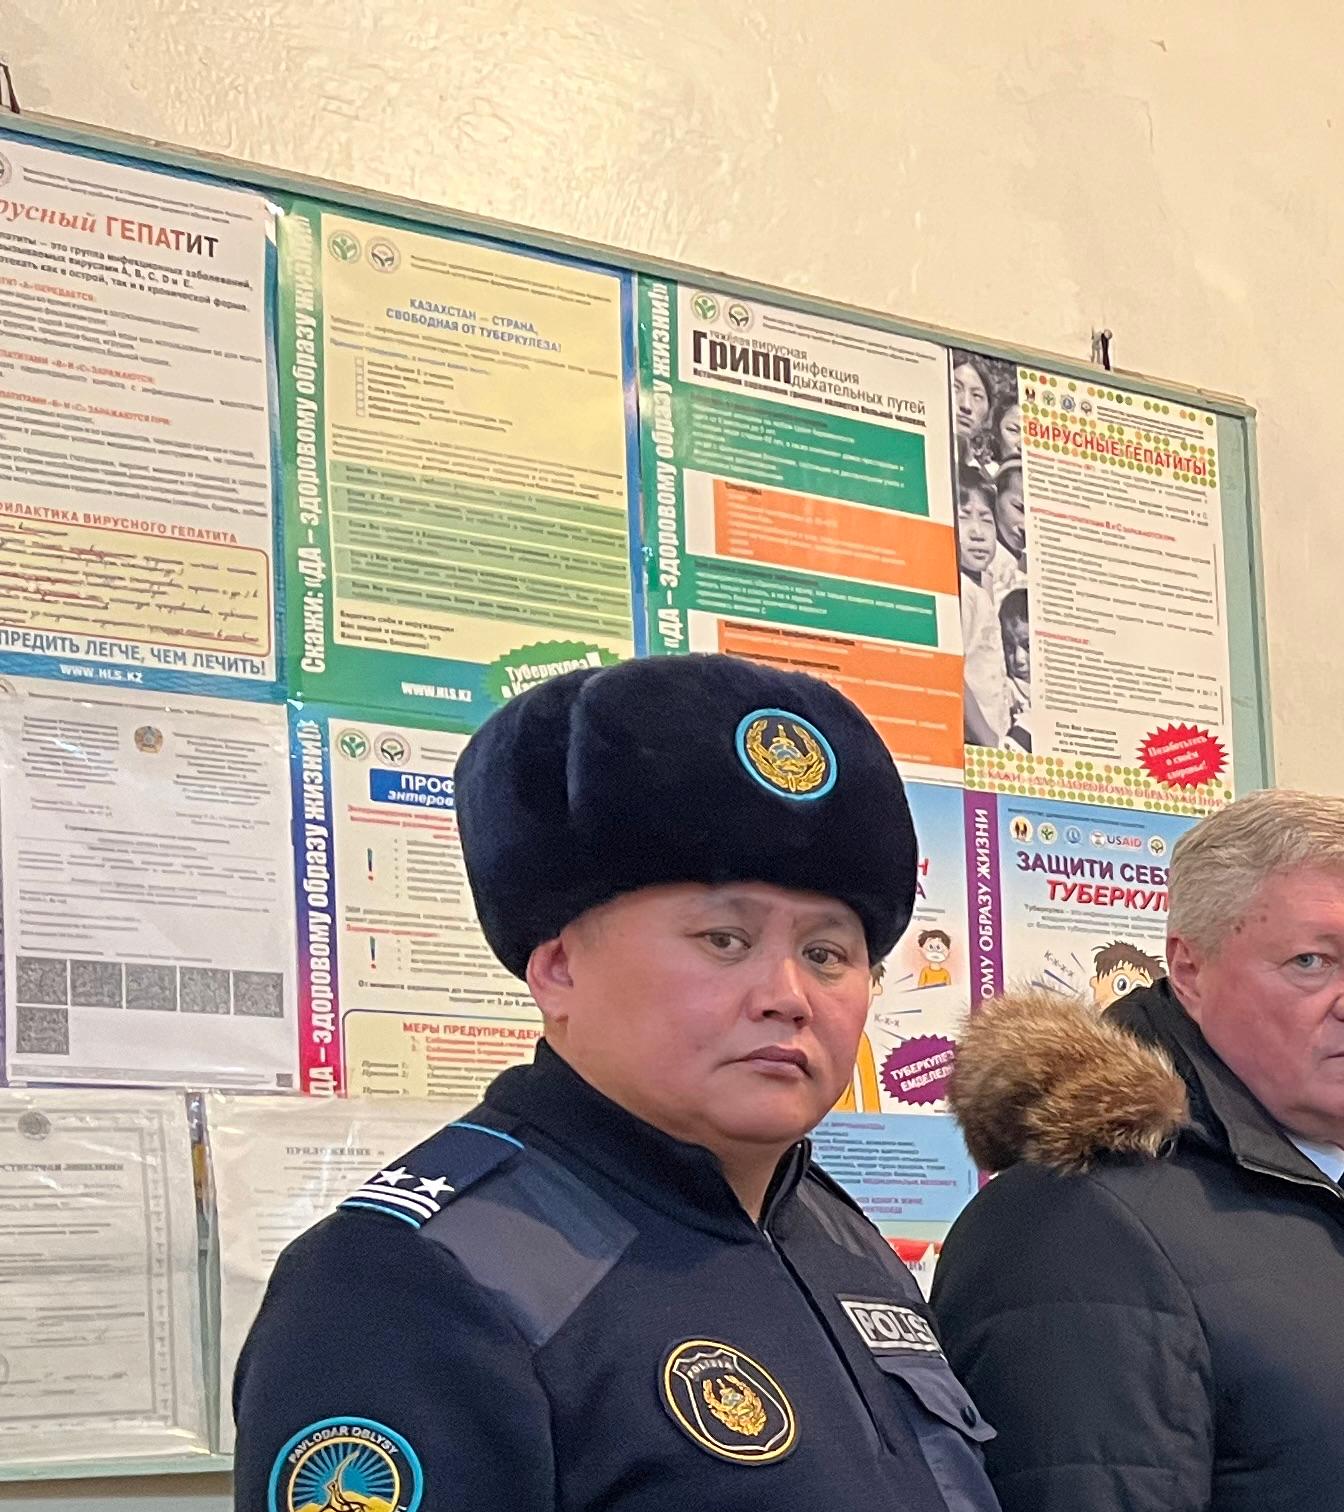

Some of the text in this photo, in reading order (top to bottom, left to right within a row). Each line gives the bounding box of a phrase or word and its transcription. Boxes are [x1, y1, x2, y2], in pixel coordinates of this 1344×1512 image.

[106, 215, 219, 258] ГЕПАТИТ
[386, 308, 562, 353] СВОБОДНАЯ ОТ ТУБЕРКУЛЕЗА!
[409, 298, 477, 321] КАЗАХСТАН
[491, 315, 538, 335] СТРАНА,
[292, 311, 318, 395] образу
[692, 329, 792, 385] Грипп
[751, 339, 808, 361] вирусная
[792, 360, 860, 386] инфекция
[791, 374, 926, 416] дыхательных путей
[651, 378, 674, 458] образу
[295, 397, 322, 527] здоровому
[1027, 421, 1122, 457] ВИРУСНЫЕ
[1125, 444, 1207, 477] ГЕПАТИТЫ
[83, 513, 167, 535] ВИРУСНОГО
[170, 525, 238, 545] ГЕПАТИТА
[656, 460, 681, 588] здоровому
[298, 546, 327, 588] «ДА
[300, 592, 326, 674] Скажи:
[658, 608, 684, 649] «ДА
[85, 639, 145, 664] ЛЕГЧЕ,
[150, 647, 187, 667] ЧЕМ
[192, 653, 266, 676] ЛЕЧИТЬ!
[974, 808, 991, 880] ЖИЗНИ
[1106, 835, 1142, 848] USAID
[303, 822, 331, 908] образу
[1016, 850, 1114, 880] ЗАЩИТИ
[977, 881, 994, 951] ОБРАЗУ
[308, 910, 336, 1044] здоровому
[403, 1022, 440, 1034] МЕРЫ
[288, 1425, 399, 1464] PAVLODAR OBLYSY
